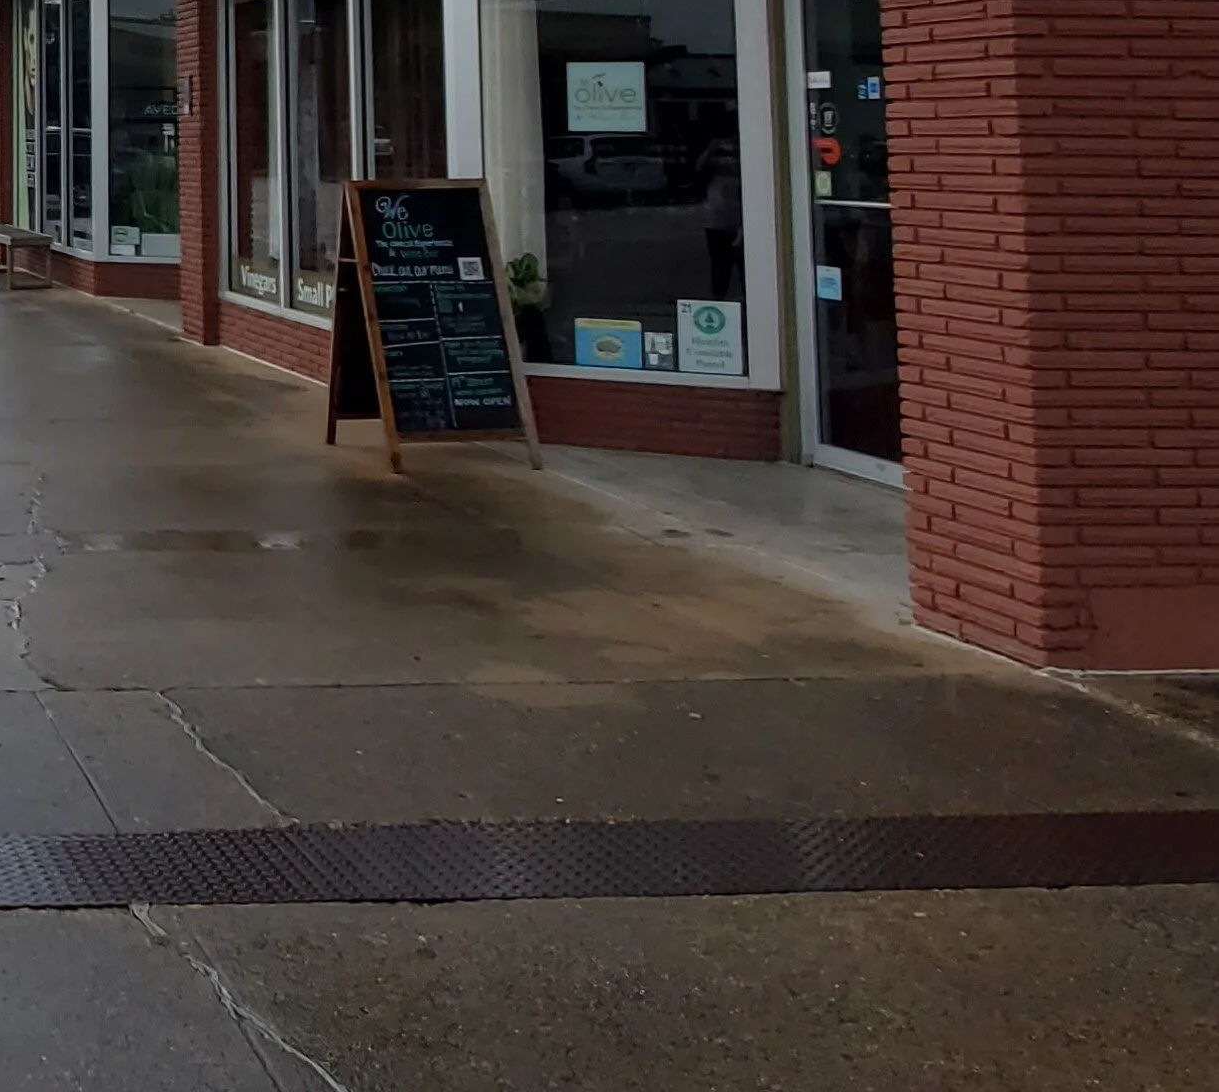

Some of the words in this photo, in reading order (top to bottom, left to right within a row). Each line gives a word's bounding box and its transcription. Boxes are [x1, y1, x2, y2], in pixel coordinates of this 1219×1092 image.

[574, 82, 636, 103] olive
[375, 194, 410, 221] We
[381, 220, 434, 240] Olive
[298, 277, 324, 307] Small
